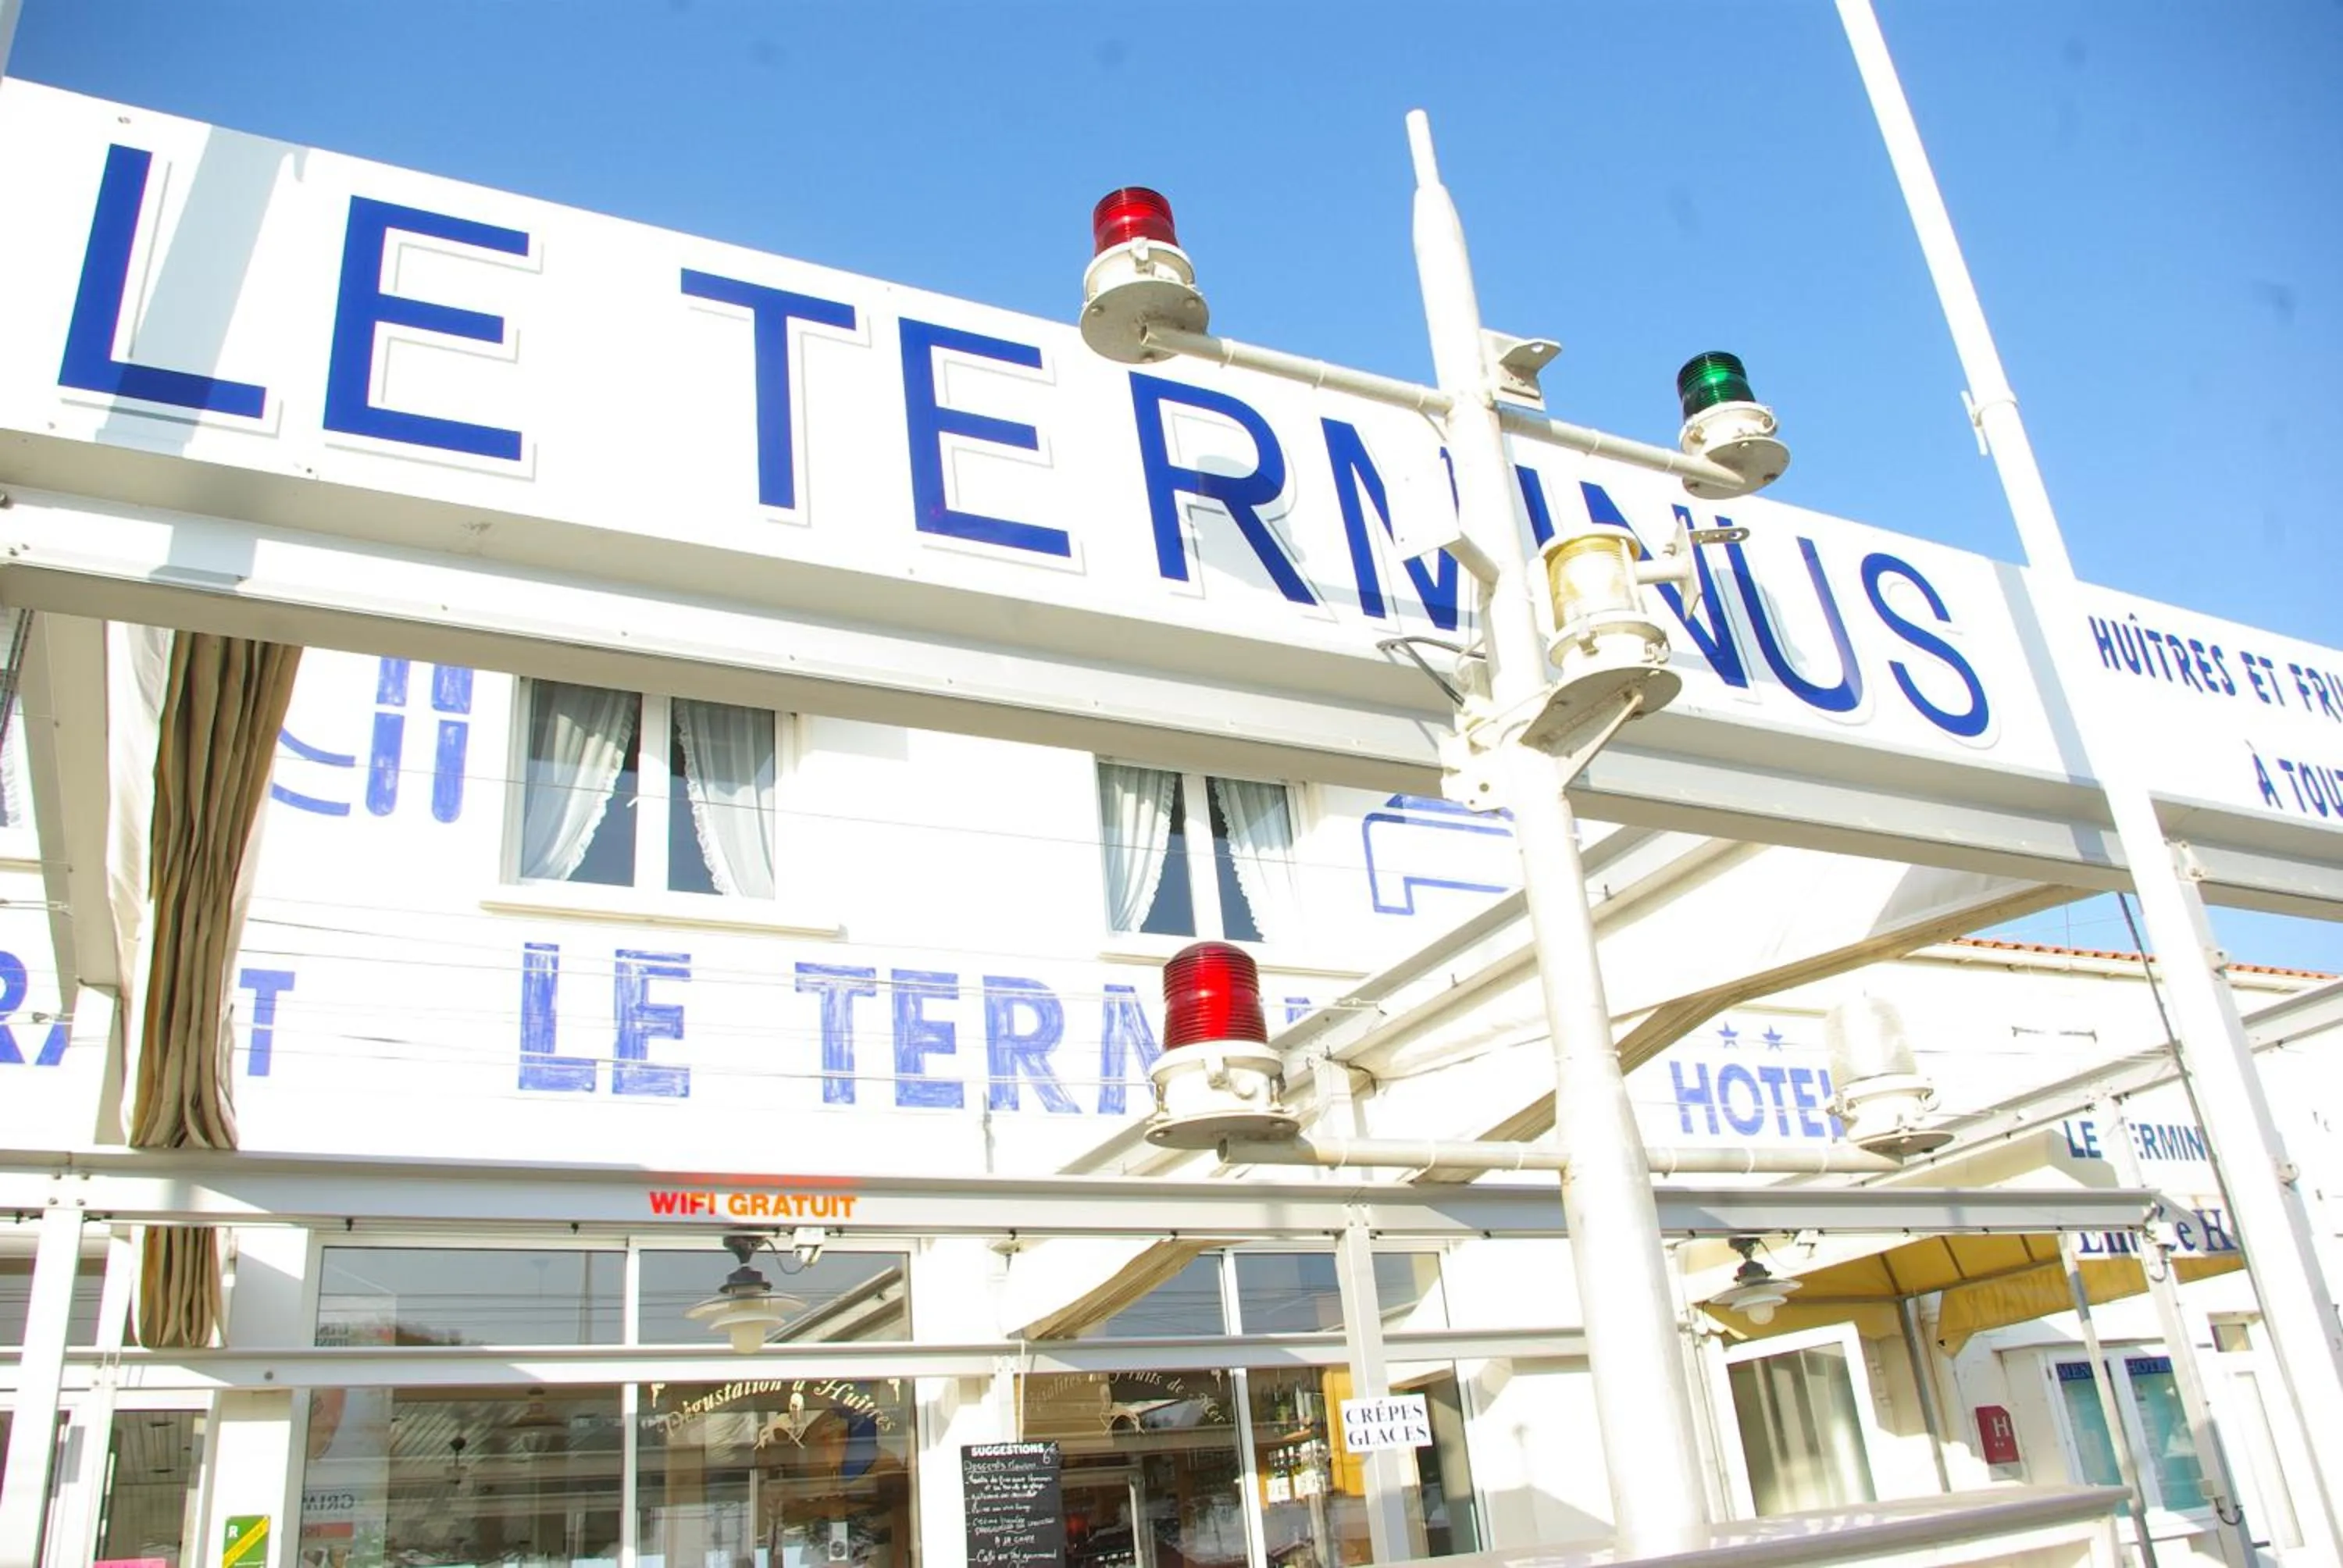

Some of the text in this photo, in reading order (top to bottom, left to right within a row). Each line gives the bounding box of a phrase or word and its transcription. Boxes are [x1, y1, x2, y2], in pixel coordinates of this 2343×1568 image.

[57, 143, 531, 462] LE
[2088, 612, 2237, 697] HUÎTRES
[2239, 650, 2286, 707] ET
[2244, 739, 2343, 820] À TOU
[518, 942, 691, 1098] LE
[1669, 1060, 1847, 1138] HOTEL
[2063, 1120, 2102, 1159] LE
[649, 1191, 857, 1218] WIFI GRATUIT
[971, 1443, 1044, 1457] SUGGESTIONS
[1349, 1425, 1427, 1446] GLACES
